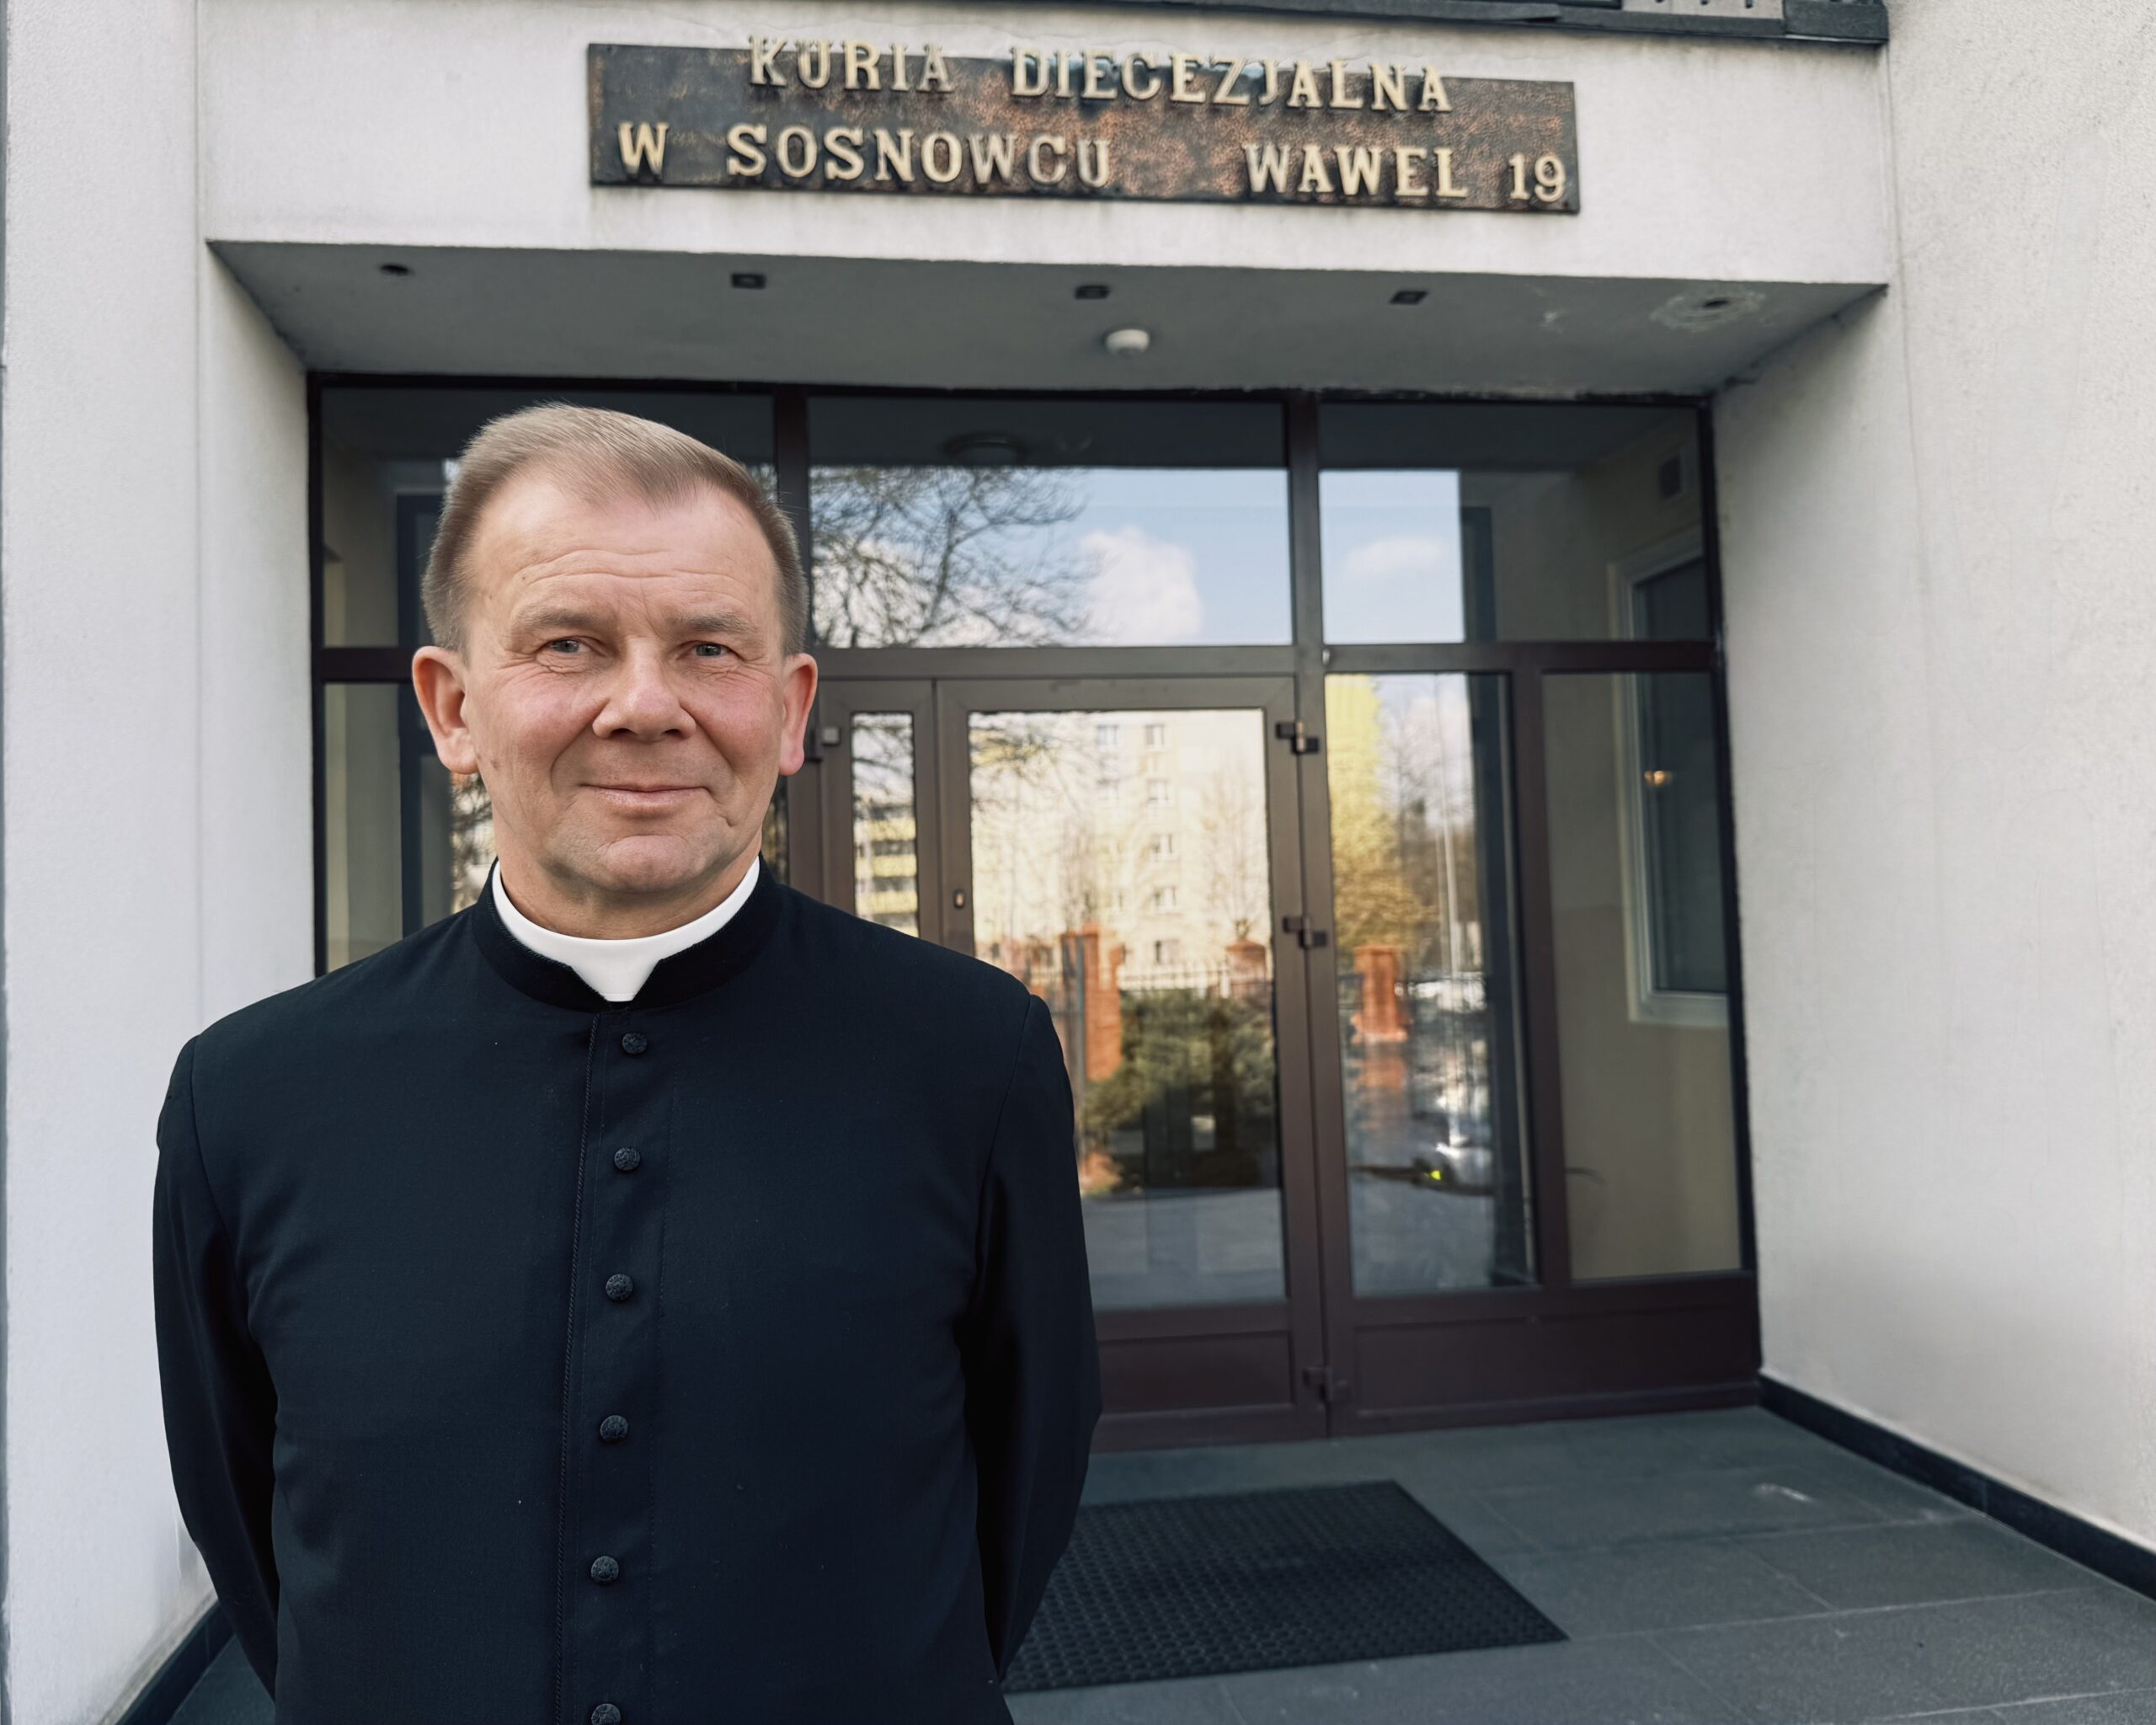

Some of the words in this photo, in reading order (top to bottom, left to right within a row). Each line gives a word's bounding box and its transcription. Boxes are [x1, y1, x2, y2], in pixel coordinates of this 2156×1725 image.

[748, 35, 954, 93] KURIA
[1010, 46, 1453, 112] DIECEZJALNA
[617, 121, 670, 178] W
[726, 123, 1112, 188] SOSNOWCU
[1242, 142, 1469, 199] WAWEL
[1508, 153, 1567, 202] 19
